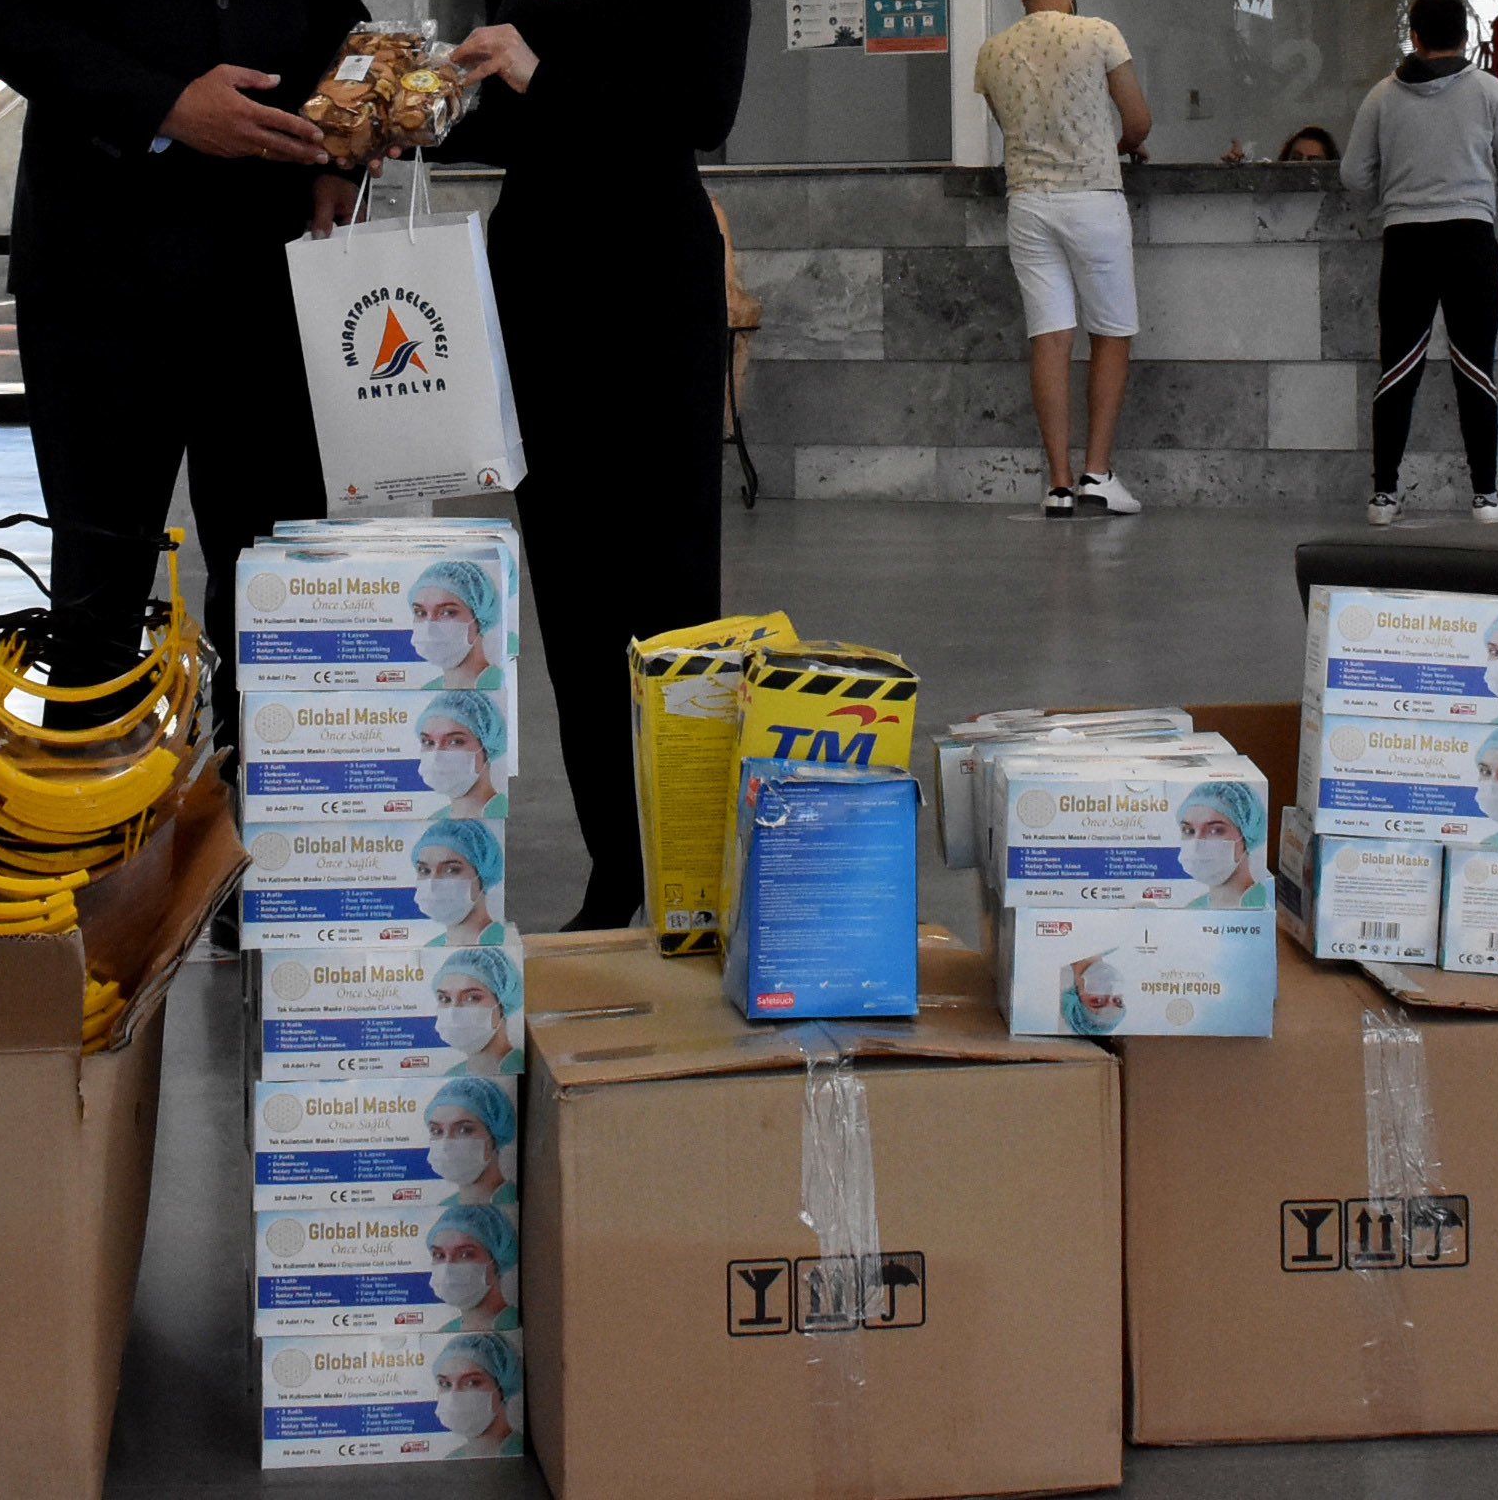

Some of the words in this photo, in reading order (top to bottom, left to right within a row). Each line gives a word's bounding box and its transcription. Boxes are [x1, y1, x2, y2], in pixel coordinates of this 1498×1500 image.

[342, 287, 389, 367] MURATPAŞA
[395, 287, 448, 359] BELEDİYESİ
[358, 378, 446, 400] ANTALYA
[289, 578, 342, 595] Global
[346, 577, 400, 595] Maske
[1377, 612, 1425, 631] Global
[1429, 615, 1478, 634] Maske
[297, 708, 350, 726] Global
[354, 707, 408, 725] Maske
[766, 724, 878, 766] TM
[1369, 733, 1417, 751] Global
[1420, 735, 1469, 754] Maske
[1059, 795, 1111, 813] Global
[1115, 795, 1169, 812] Maske
[293, 836, 346, 854] Global
[350, 836, 404, 853] Maske
[1362, 852, 1394, 866] Global
[1396, 855, 1430, 868] Maske
[313, 965, 366, 984] Global
[370, 965, 424, 983] Maske
[1141, 981, 1181, 994] Maske
[1182, 981, 1221, 995] Global
[757, 995, 794, 1008] Safetouch
[306, 1097, 358, 1115] Global
[363, 1096, 416, 1113] Maske
[308, 1222, 361, 1240] Global
[365, 1220, 419, 1238] Maske
[314, 1353, 367, 1370] Global
[371, 1351, 425, 1368] Maske
